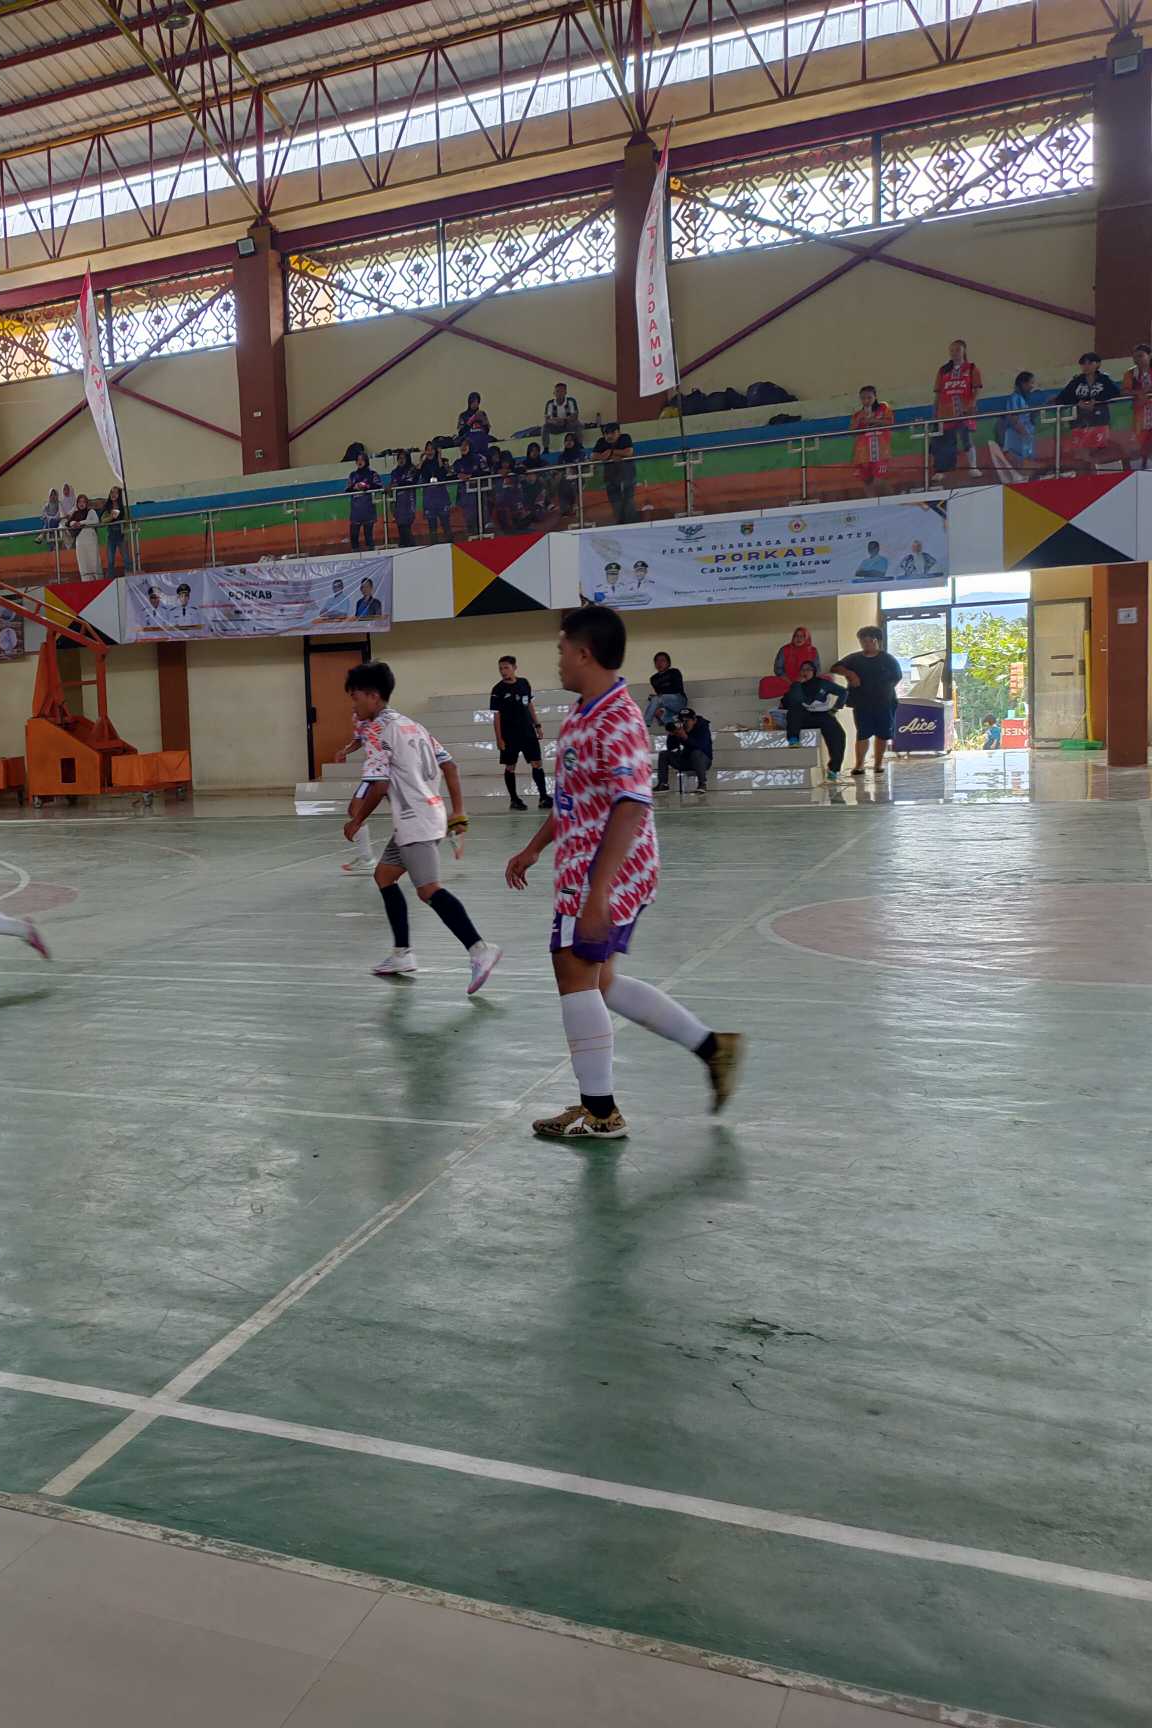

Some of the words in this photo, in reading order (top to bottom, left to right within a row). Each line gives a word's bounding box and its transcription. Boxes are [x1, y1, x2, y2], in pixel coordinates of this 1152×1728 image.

[714, 547, 816, 563] PORKAB
[700, 564, 737, 574] Cabor
[743, 561, 779, 572] Sepak
[786, 558, 832, 568] Takraw
[228, 590, 272, 601] PORKAB
[898, 717, 936, 733] Aice
[1002, 727, 1028, 736] NESI
